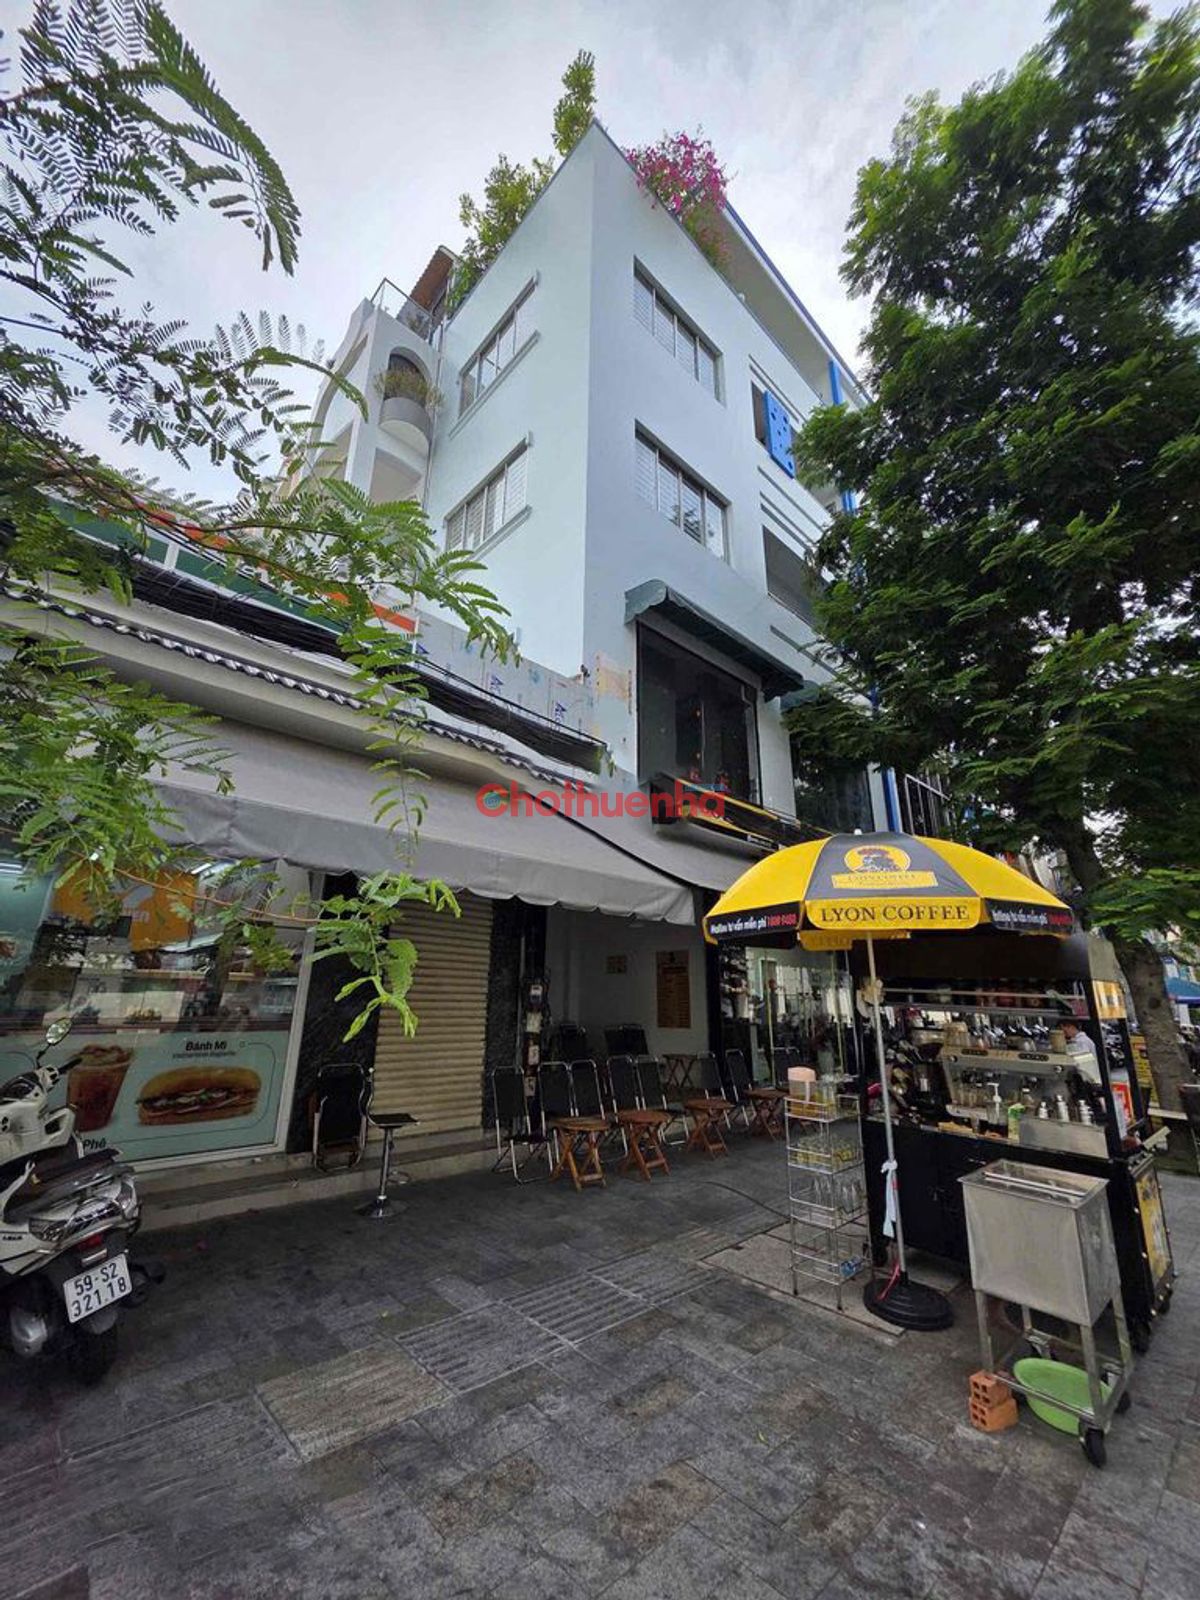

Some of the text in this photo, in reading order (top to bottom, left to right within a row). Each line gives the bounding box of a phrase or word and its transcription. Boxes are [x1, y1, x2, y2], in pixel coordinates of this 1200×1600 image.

[821, 904, 970, 922] LYON COFFEE
[185, 1040, 213, 1051] Bánh
[74, 1263, 118, 1296] 59-S2
